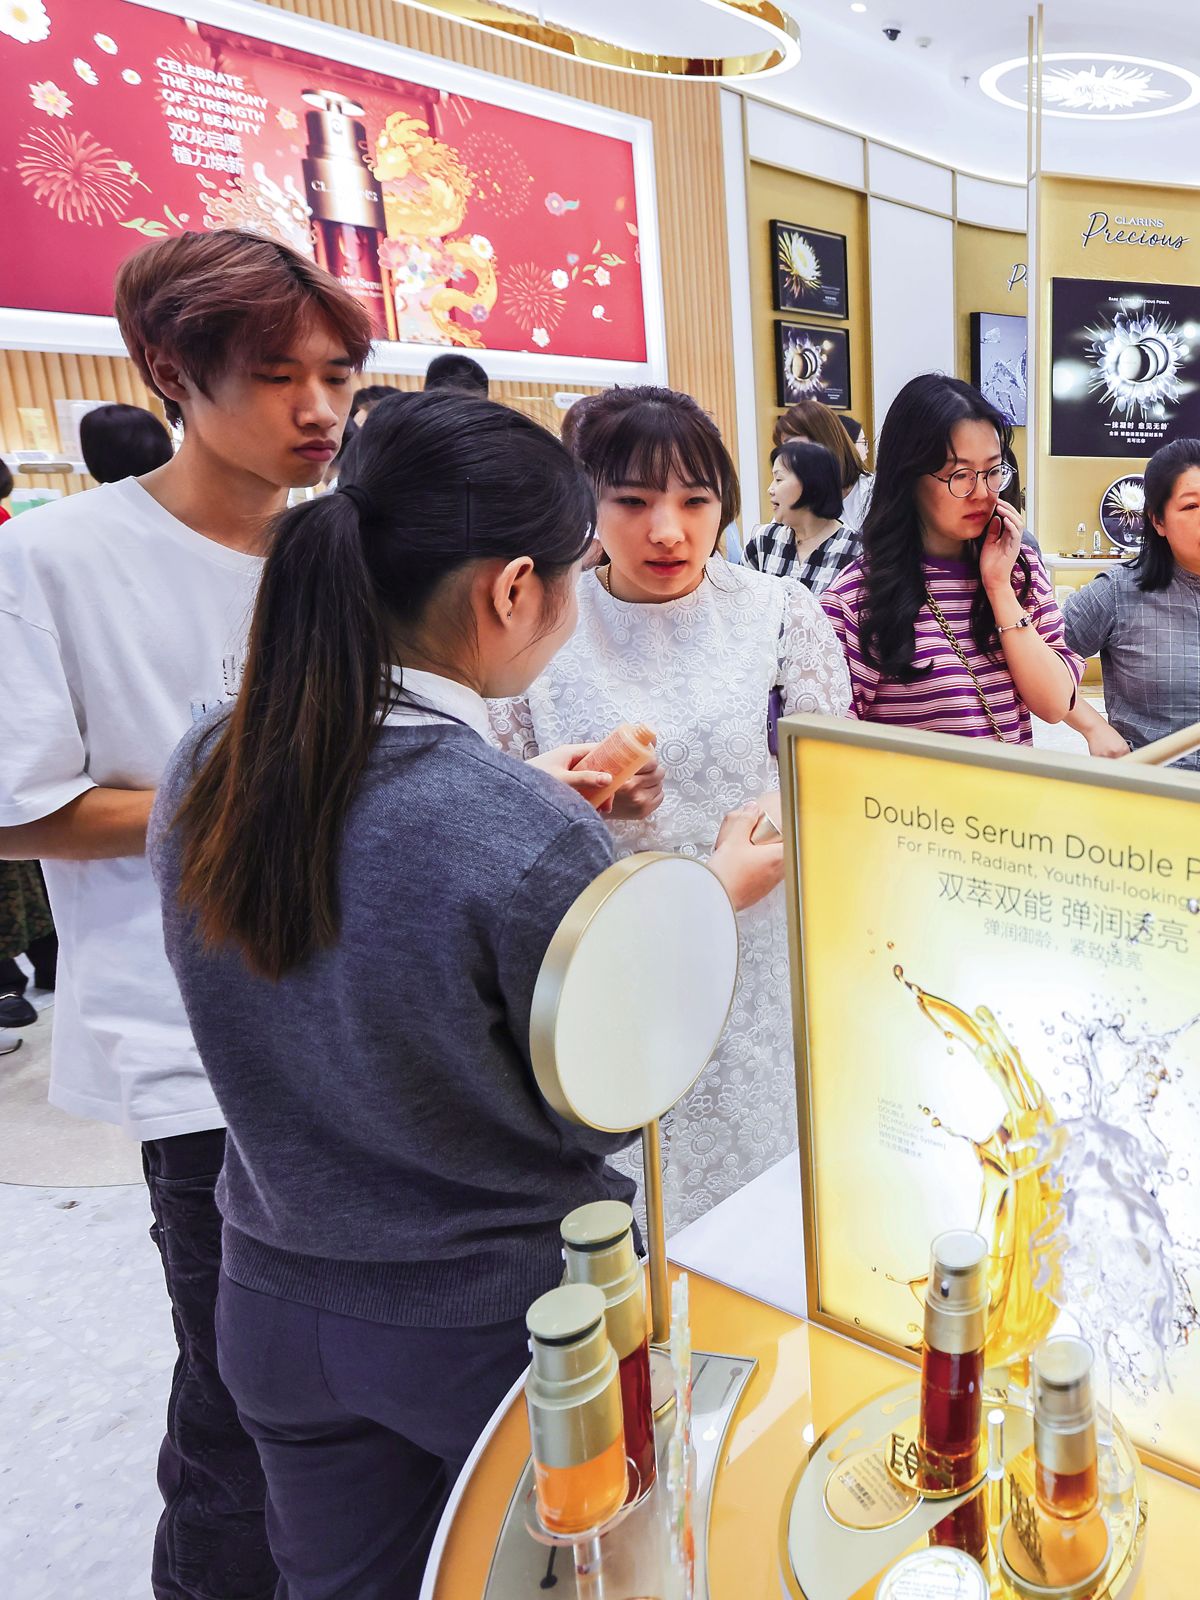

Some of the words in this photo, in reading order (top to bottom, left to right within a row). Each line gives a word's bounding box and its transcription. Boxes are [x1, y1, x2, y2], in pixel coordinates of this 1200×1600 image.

[156, 57, 244, 90] CELEBRATE
[158, 72, 193, 92] THE
[192, 80, 268, 109] HARMONY
[161, 88, 185, 103] OF
[187, 94, 266, 123] STRENGTH
[165, 104, 200, 122] AND
[202, 112, 261, 136] BEAUTY
[1081, 211, 1192, 251] Precious
[1114, 215, 1165, 229] CLARINS
[864, 796, 955, 835] Double
[965, 815, 1053, 855] Serum
[1066, 834, 1173, 878] Double
[897, 836, 922, 853] For
[927, 841, 966, 865] Firm,
[971, 851, 1038, 879] Radiant,
[1043, 865, 1191, 914] Youthful-looking
[938, 871, 1053, 924] 双萃双能
[1061, 897, 1189, 954] 弹润透亮
